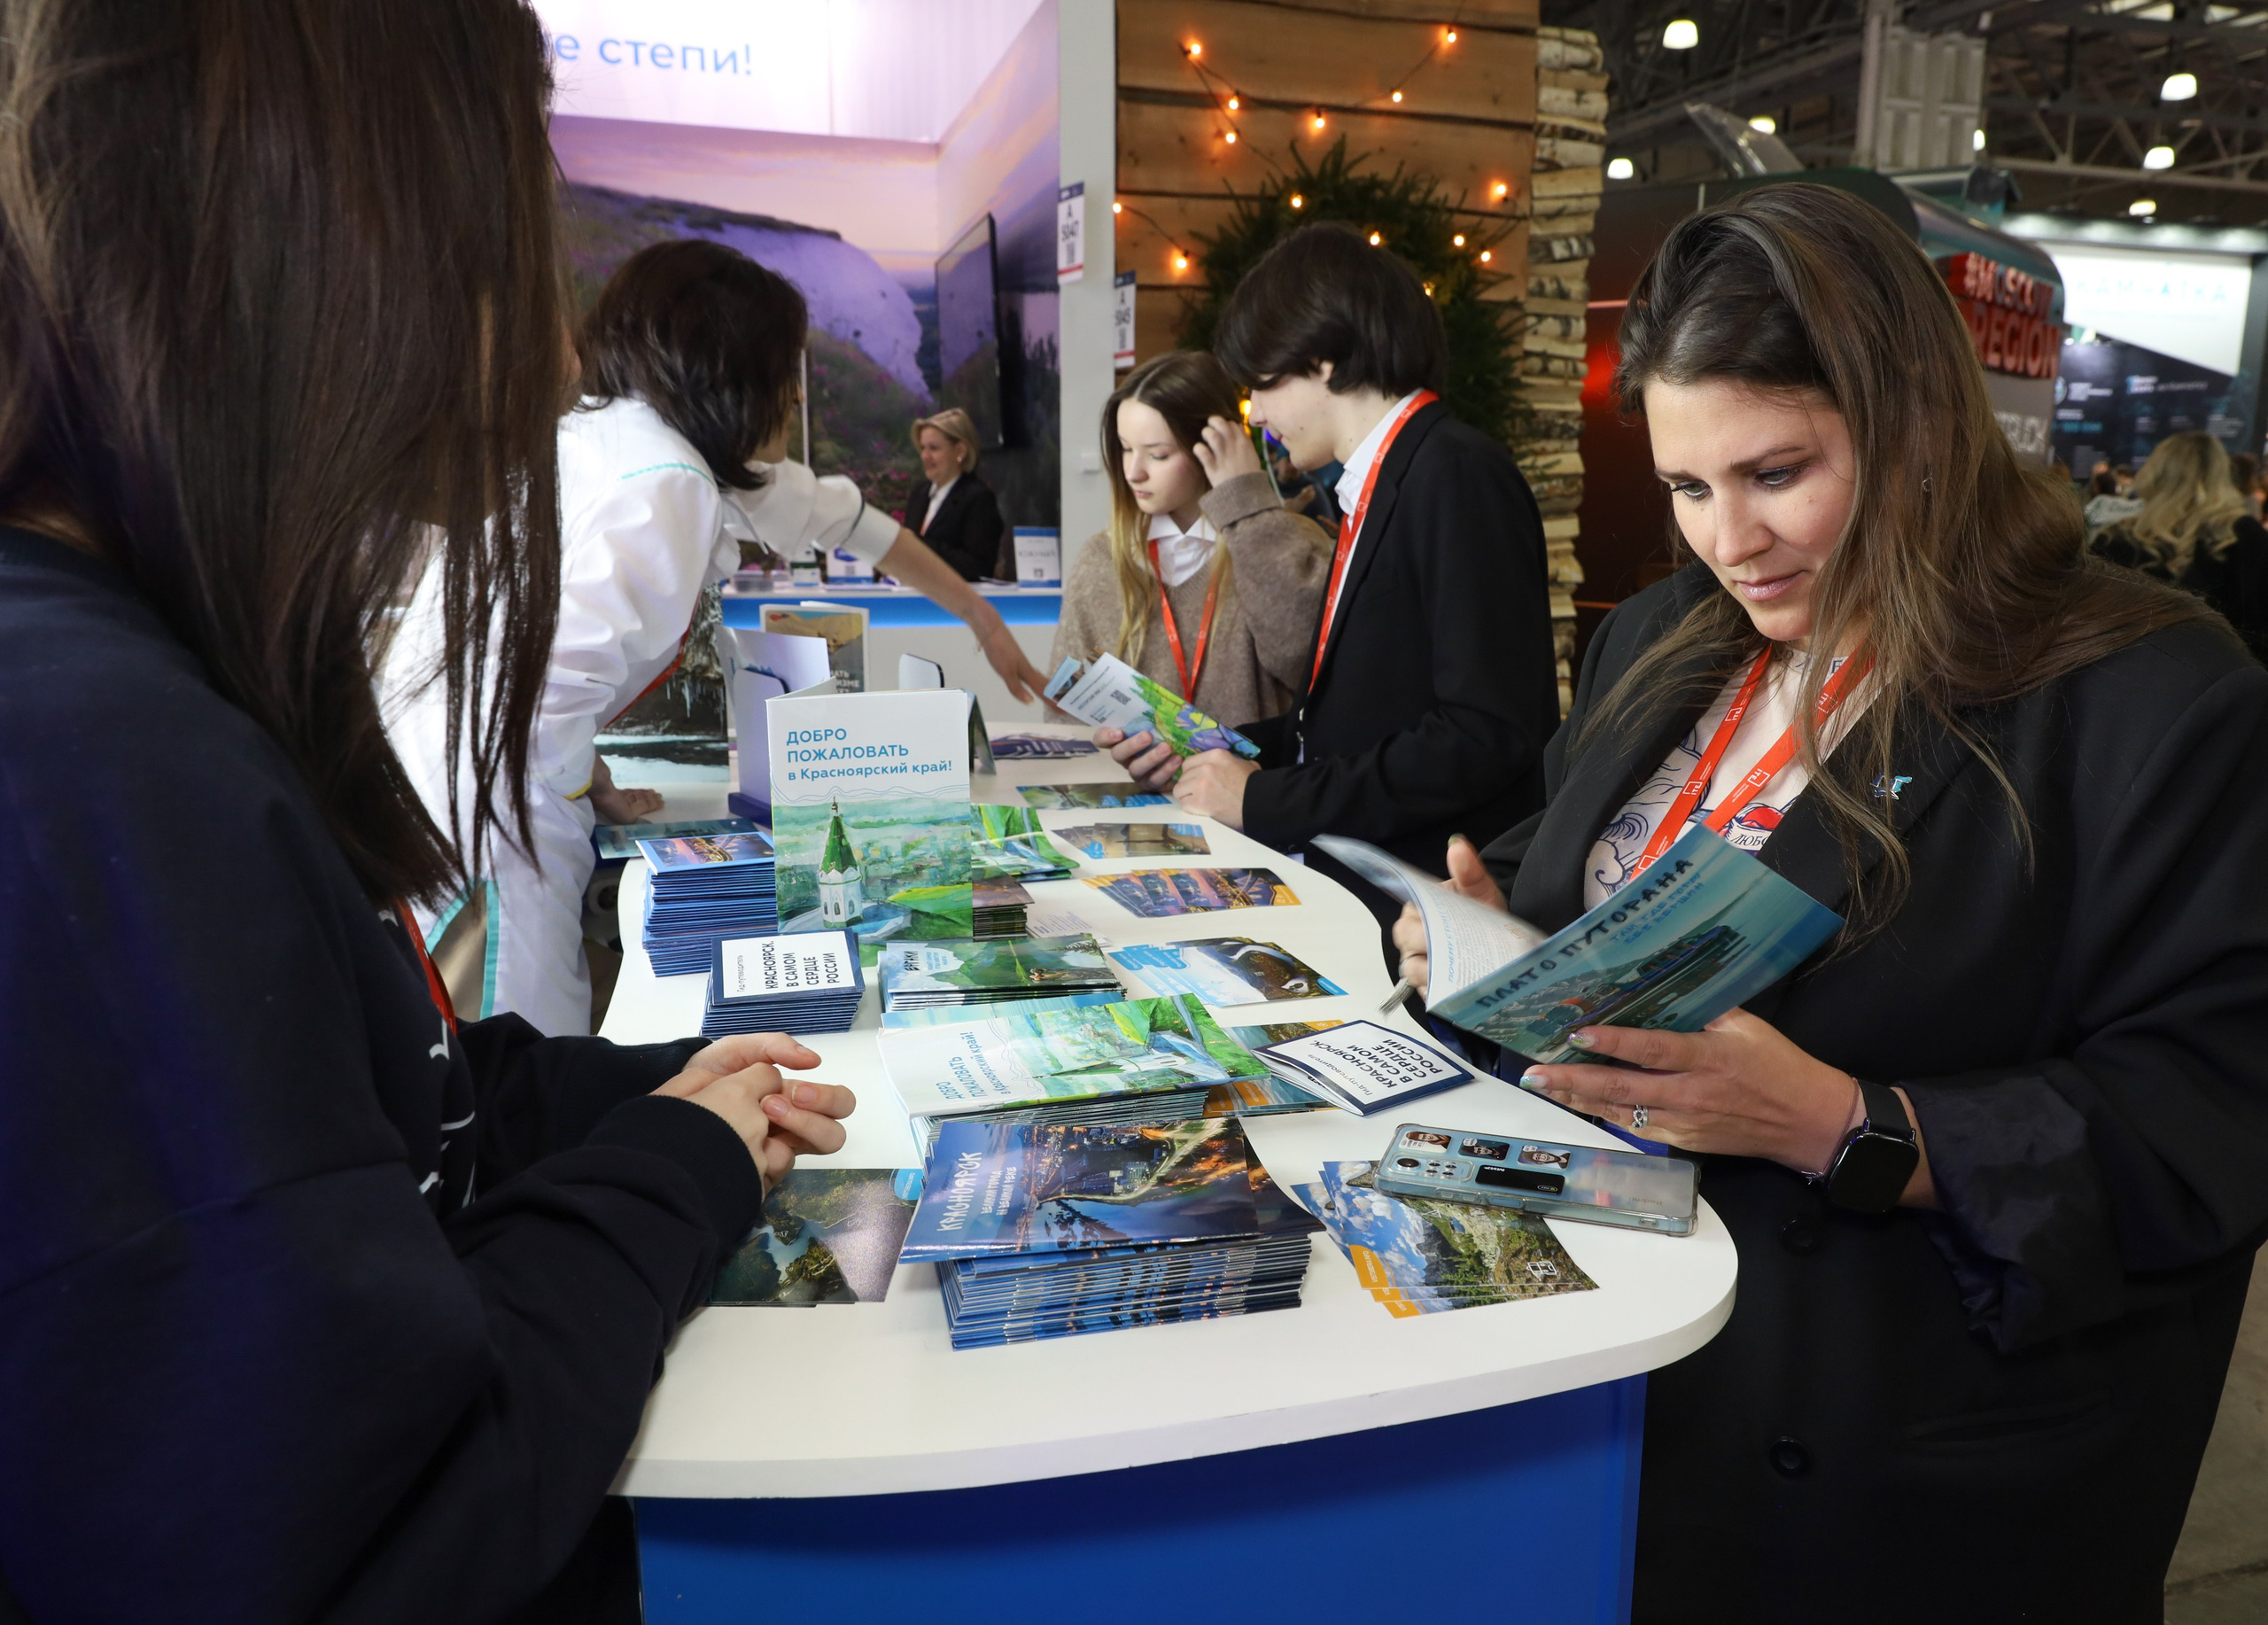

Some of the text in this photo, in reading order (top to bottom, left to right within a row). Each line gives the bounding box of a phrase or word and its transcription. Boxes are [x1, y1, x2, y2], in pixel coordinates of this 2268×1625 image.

[599, 38, 751, 75] степи!
[1973, 301, 2062, 379] REGION
[835, 680, 860, 688] ИЗМЕ
[787, 728, 847, 746] ДОБРО
[788, 744, 909, 764] ПОЖАЛОВАТЬ
[788, 760, 952, 781] в Красноярский край!
[1475, 959, 1557, 1008] ПЛАТО
[1558, 859, 1694, 958] ПУТОРАНА
[761, 940, 779, 990] КРАСНОЯРСК.
[782, 952, 798, 980] САМОМ
[803, 956, 819, 985] СЕРДЦЕ
[822, 952, 841, 984] РОССИИ
[959, 1031, 983, 1054] край!
[1382, 1039, 1443, 1074] РОССИИ
[948, 1055, 988, 1098] ПОЖАЛОВАТЬ
[970, 1054, 1011, 1092] Красноярский
[1309, 1039, 1398, 1088] КРАСНОЯРСК.
[1347, 1045, 1401, 1076] САМОМ
[1372, 1045, 1427, 1078] СЕРДЦЕ
[936, 1080, 967, 1100] ДОБРО
[1003, 1166, 1018, 1184] РЕКЕ
[936, 1152, 983, 1232] КРАСНОЯРСК
